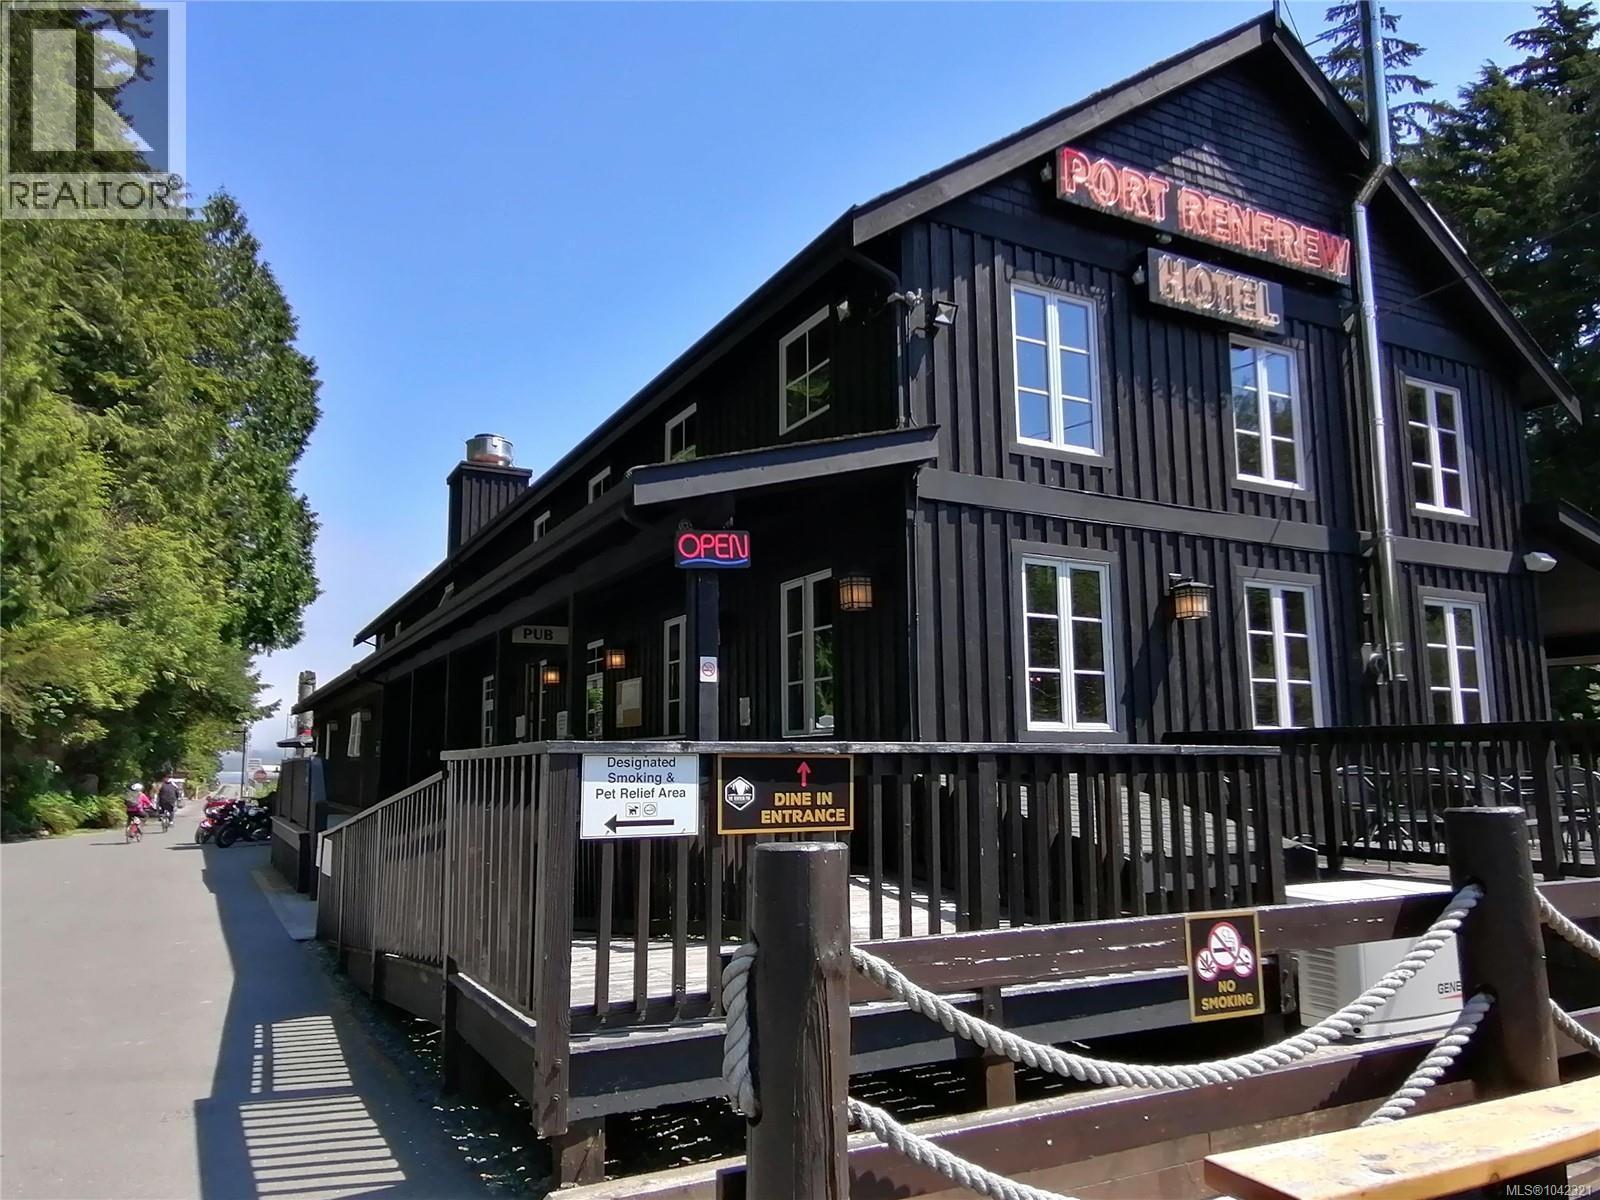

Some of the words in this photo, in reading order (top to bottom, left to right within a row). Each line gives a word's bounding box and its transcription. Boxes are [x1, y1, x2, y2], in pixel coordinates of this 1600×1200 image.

[1062, 147, 1169, 222] PORT
[1177, 187, 1350, 276] RENFREW
[1158, 254, 1280, 326] HOTEL
[678, 532, 749, 559] OPEN
[523, 627, 554, 641] PUB
[607, 756, 676, 771] Designated
[607, 772, 662, 785] Smoking
[666, 772, 675, 784] &
[595, 788, 616, 800] Pet
[620, 787, 657, 799] Relief
[660, 787, 686, 798] Area
[774, 792, 811, 807] DINE
[816, 791, 833, 805] IN
[761, 808, 846, 824] ENTRANCE
[1218, 980, 1236, 993] NO
[1201, 993, 1254, 1010] SMOKING
